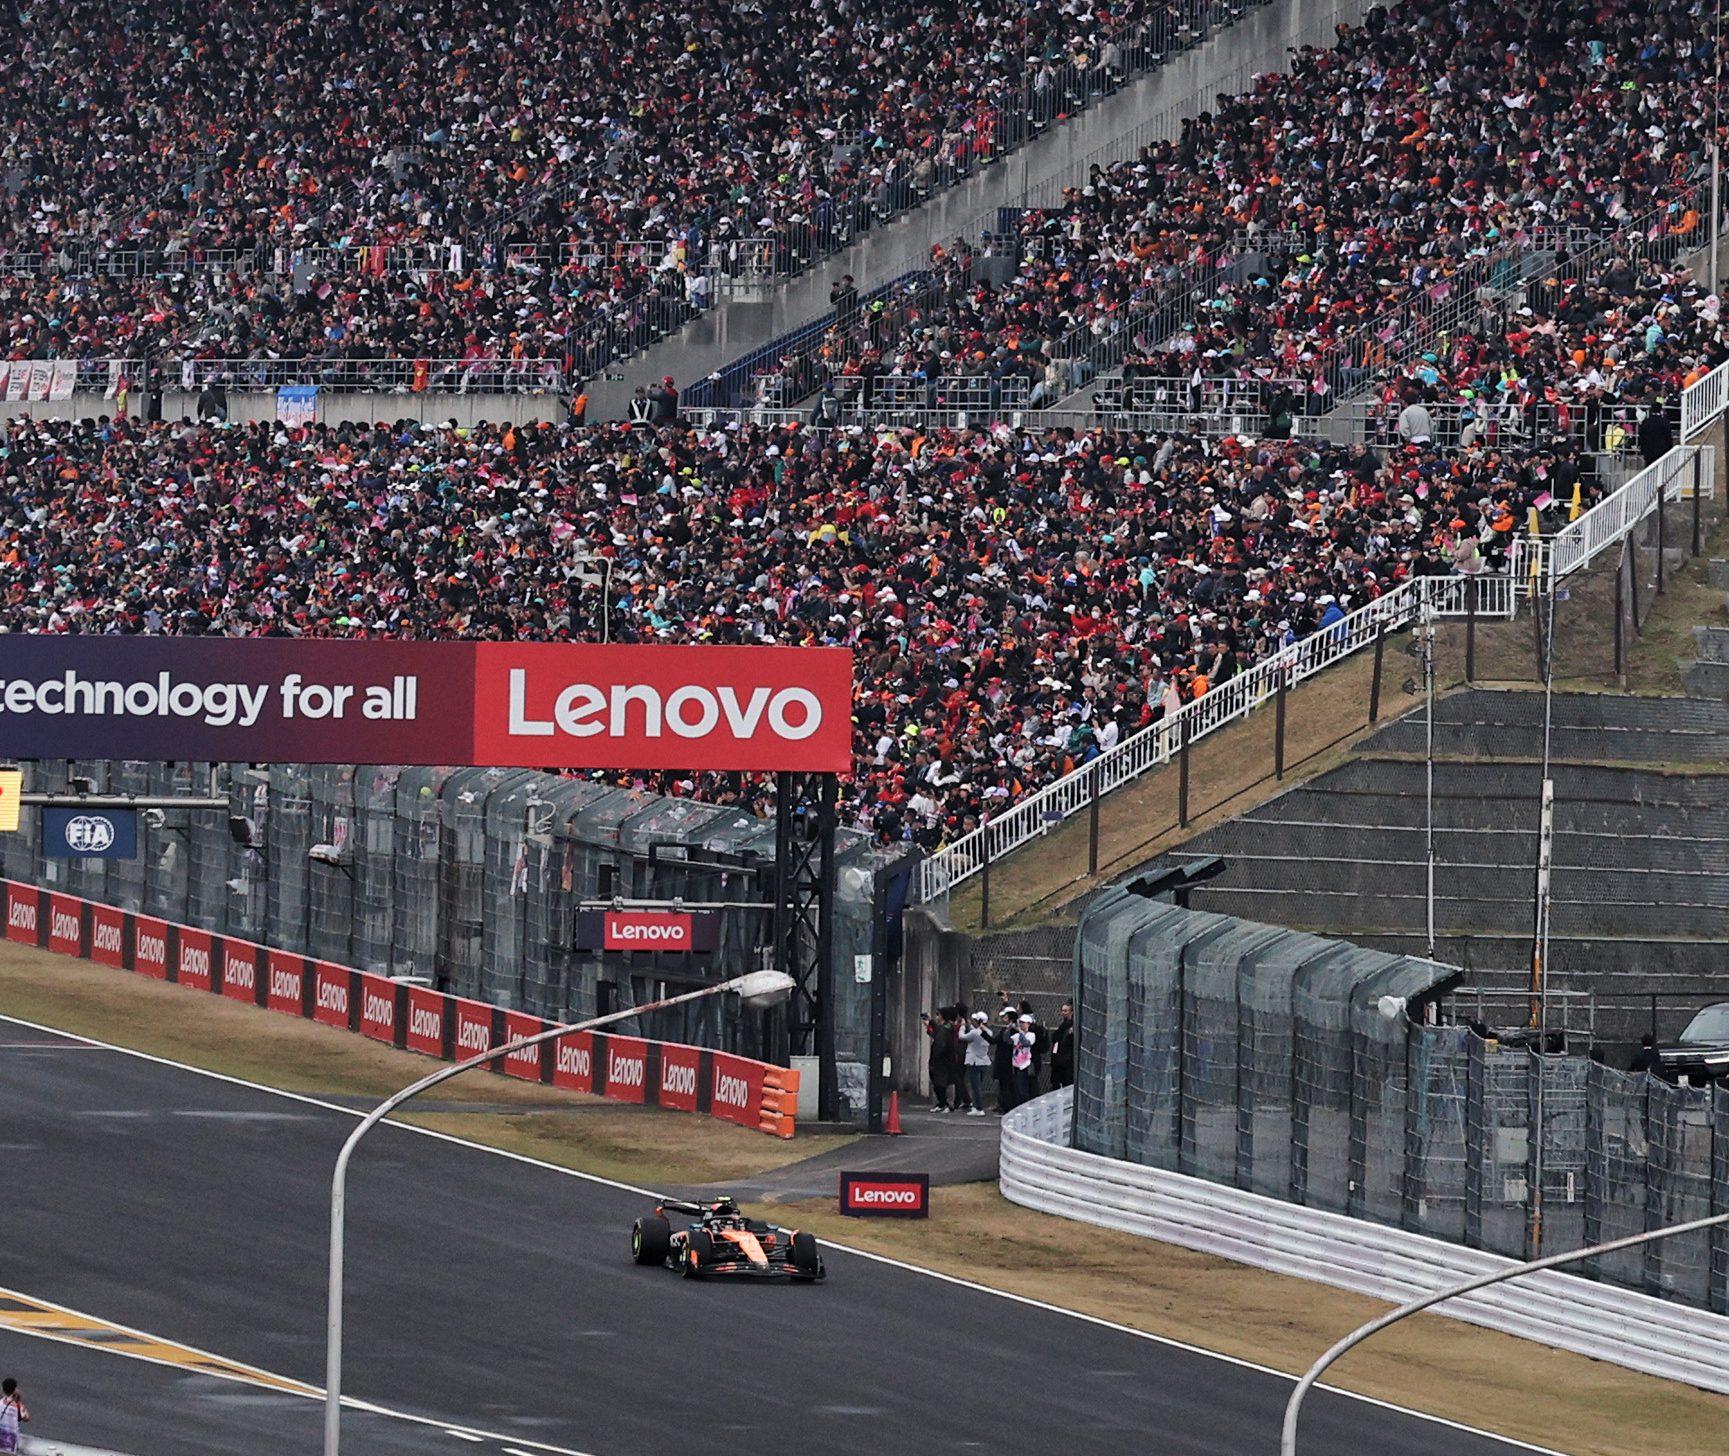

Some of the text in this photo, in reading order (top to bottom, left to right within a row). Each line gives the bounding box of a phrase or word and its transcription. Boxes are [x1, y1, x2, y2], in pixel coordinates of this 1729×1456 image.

[281, 674, 354, 719] for
[362, 676, 417, 720] all
[508, 668, 822, 740] Lenovo
[67, 823, 114, 845] FIA
[9, 895, 36, 931] Lenovo
[52, 905, 80, 942] Lenovo
[611, 921, 684, 940] Lenovo
[94, 916, 121, 953] Lenovo
[137, 928, 165, 965] Lenovo
[180, 939, 209, 977] Lenovo
[225, 950, 254, 990] Lenovo
[271, 962, 301, 1002] Lenovo
[317, 974, 348, 1014] Lenovo
[363, 986, 393, 1027] Lenovo
[410, 999, 440, 1040] Lenovo
[458, 1012, 490, 1053] Lenovo
[556, 1037, 590, 1077] Lenovo
[608, 1048, 643, 1087] Lenovo
[662, 1055, 695, 1096] Lenovo
[715, 1065, 748, 1108] Lenovo
[854, 1187, 915, 1203] Lenovo
